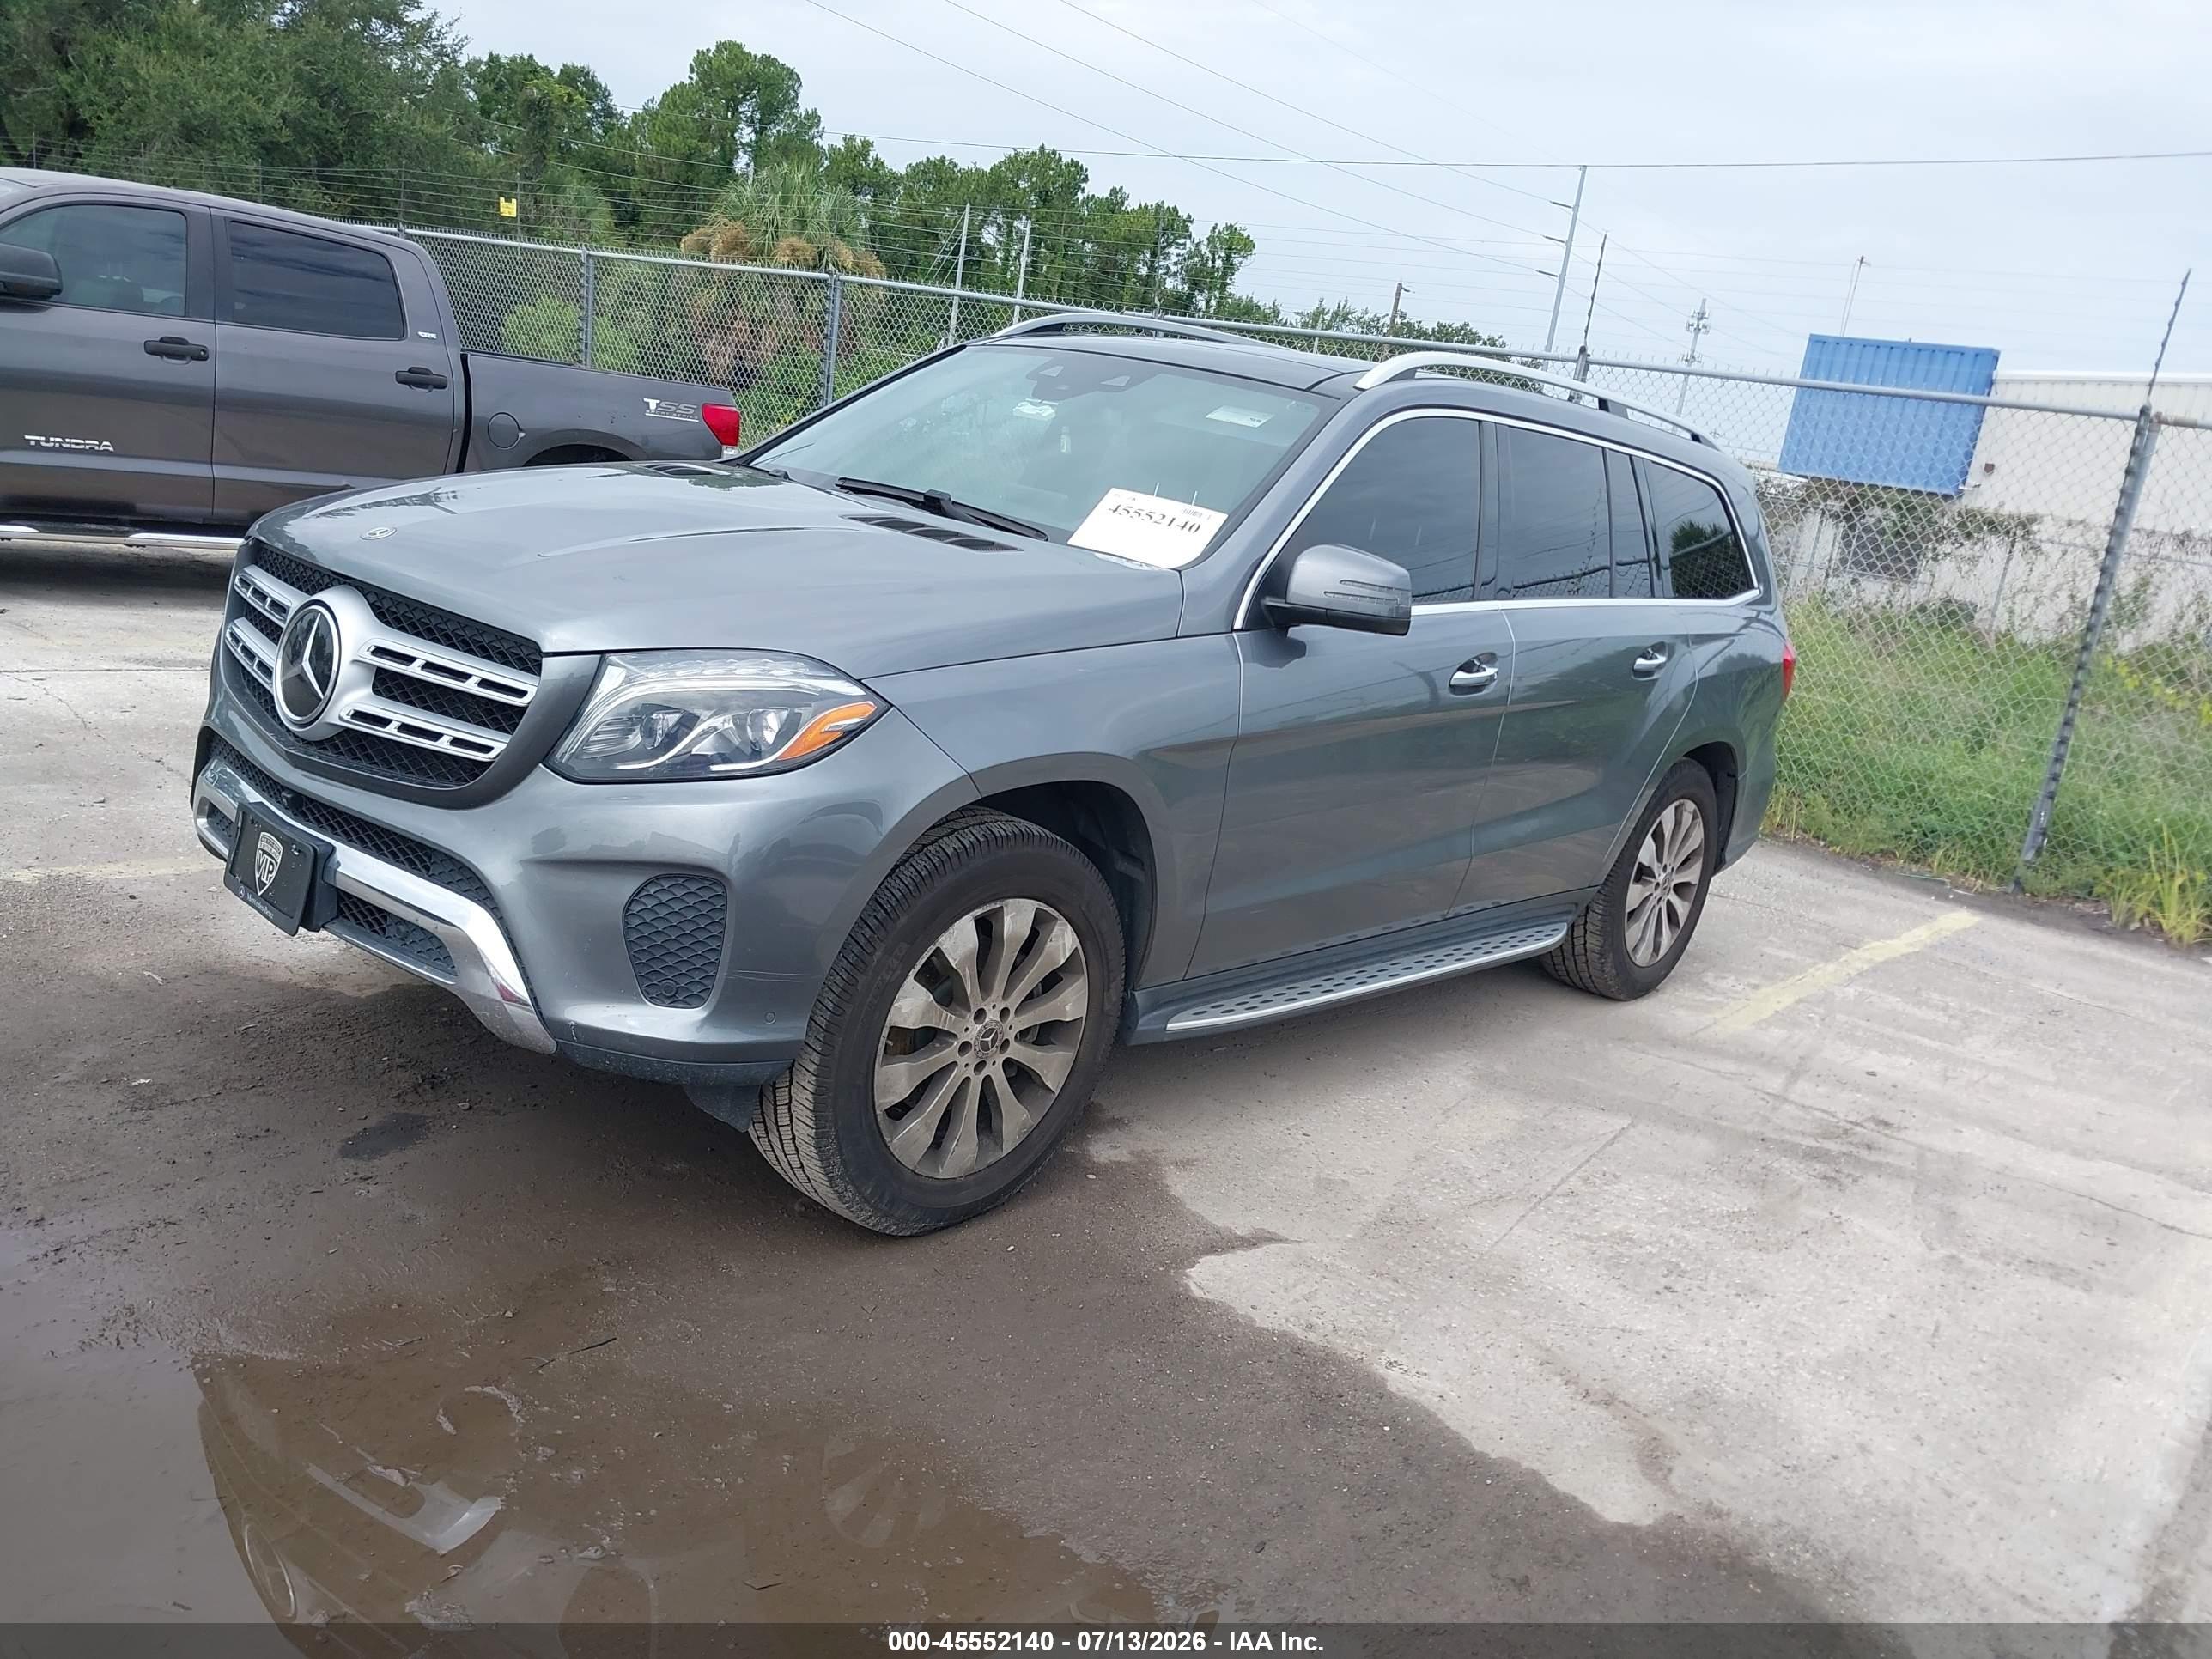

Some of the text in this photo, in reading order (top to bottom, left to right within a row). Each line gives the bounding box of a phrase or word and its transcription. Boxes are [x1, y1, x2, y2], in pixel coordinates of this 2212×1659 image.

[643, 398, 698, 415] TSS
[24, 434, 114, 452] TUNDRA
[1108, 503, 1202, 535] 45552140
[257, 849, 276, 884] VIP
